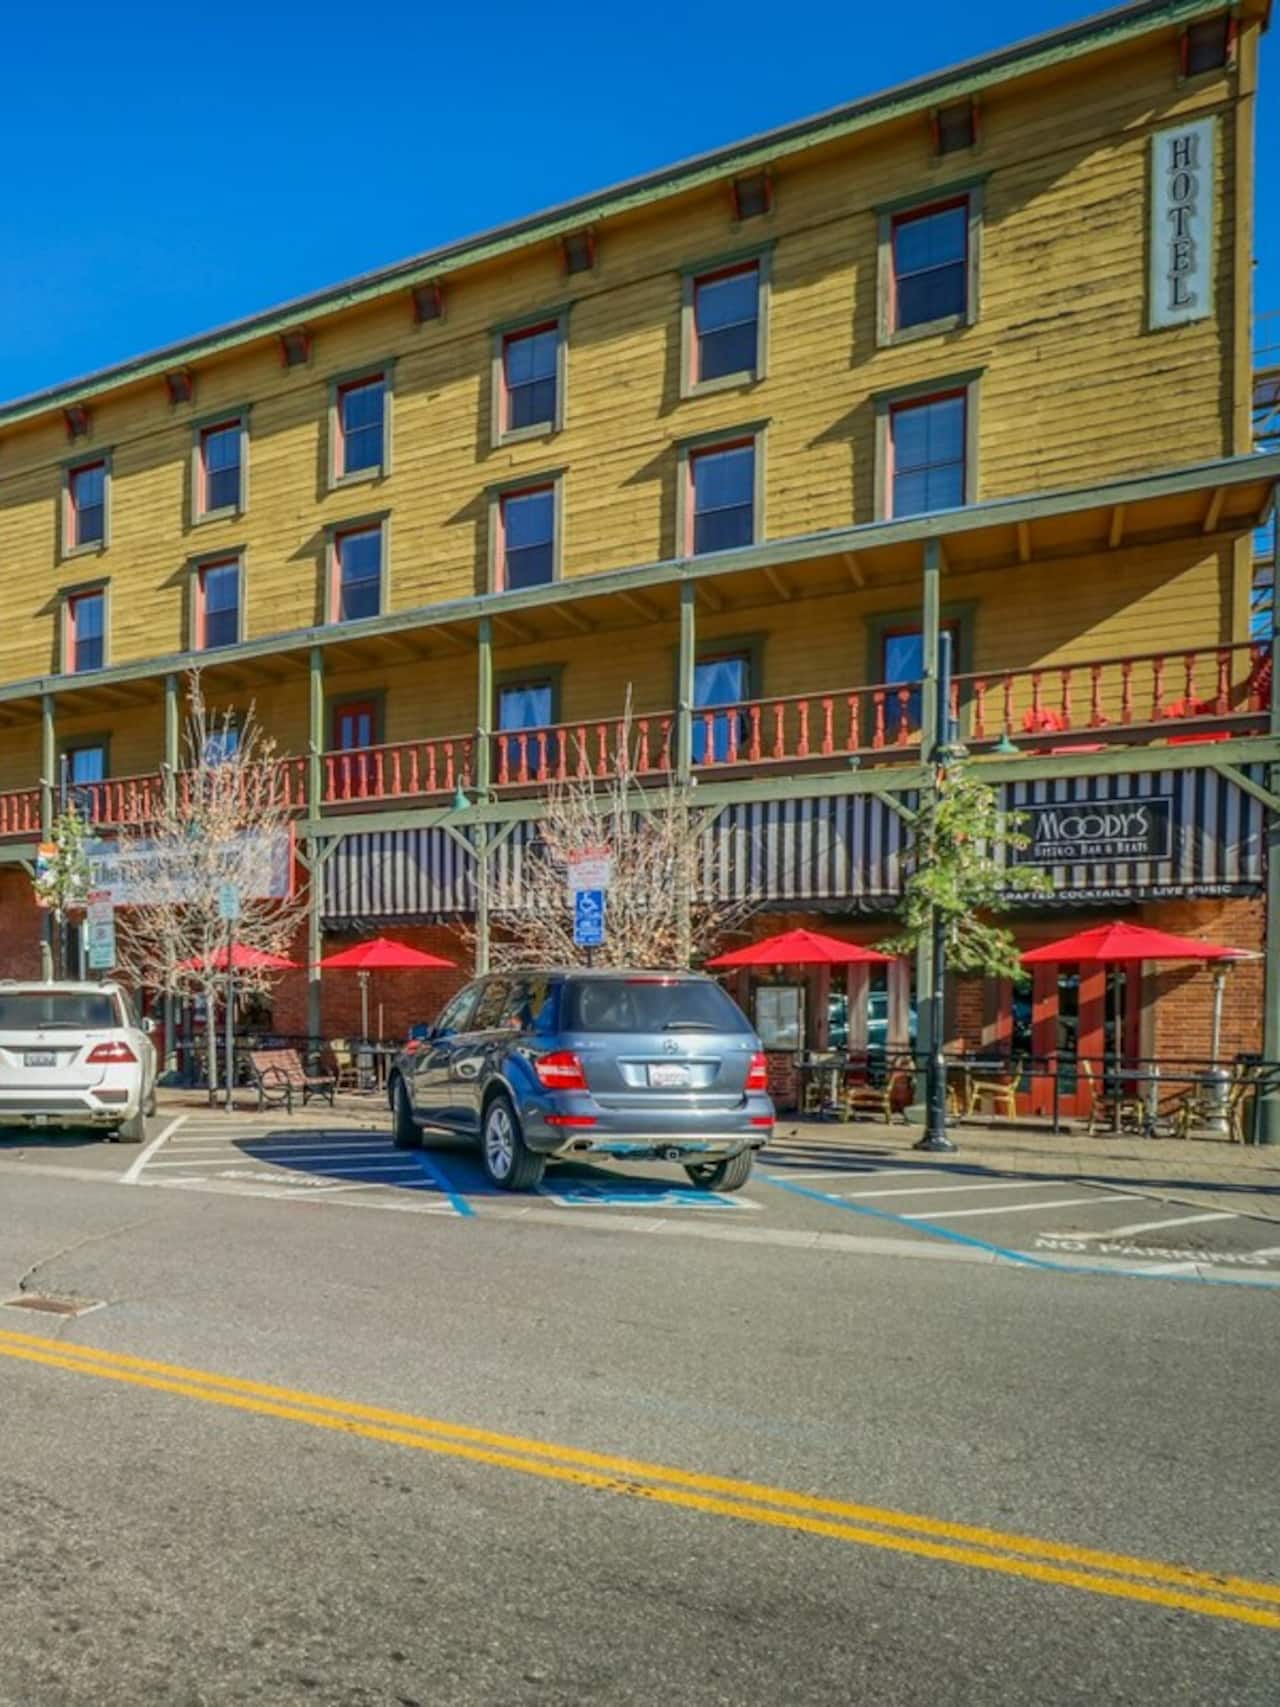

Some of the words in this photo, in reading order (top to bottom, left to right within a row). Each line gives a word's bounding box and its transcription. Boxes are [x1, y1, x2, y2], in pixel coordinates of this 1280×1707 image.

[1168, 135, 1195, 307] HOTEL
[1059, 887, 1131, 899] COCKTAILS
[1152, 885, 1184, 896] LIVE
[1035, 1239, 1087, 1251] NO
[1099, 1243, 1268, 1265] PARKING
